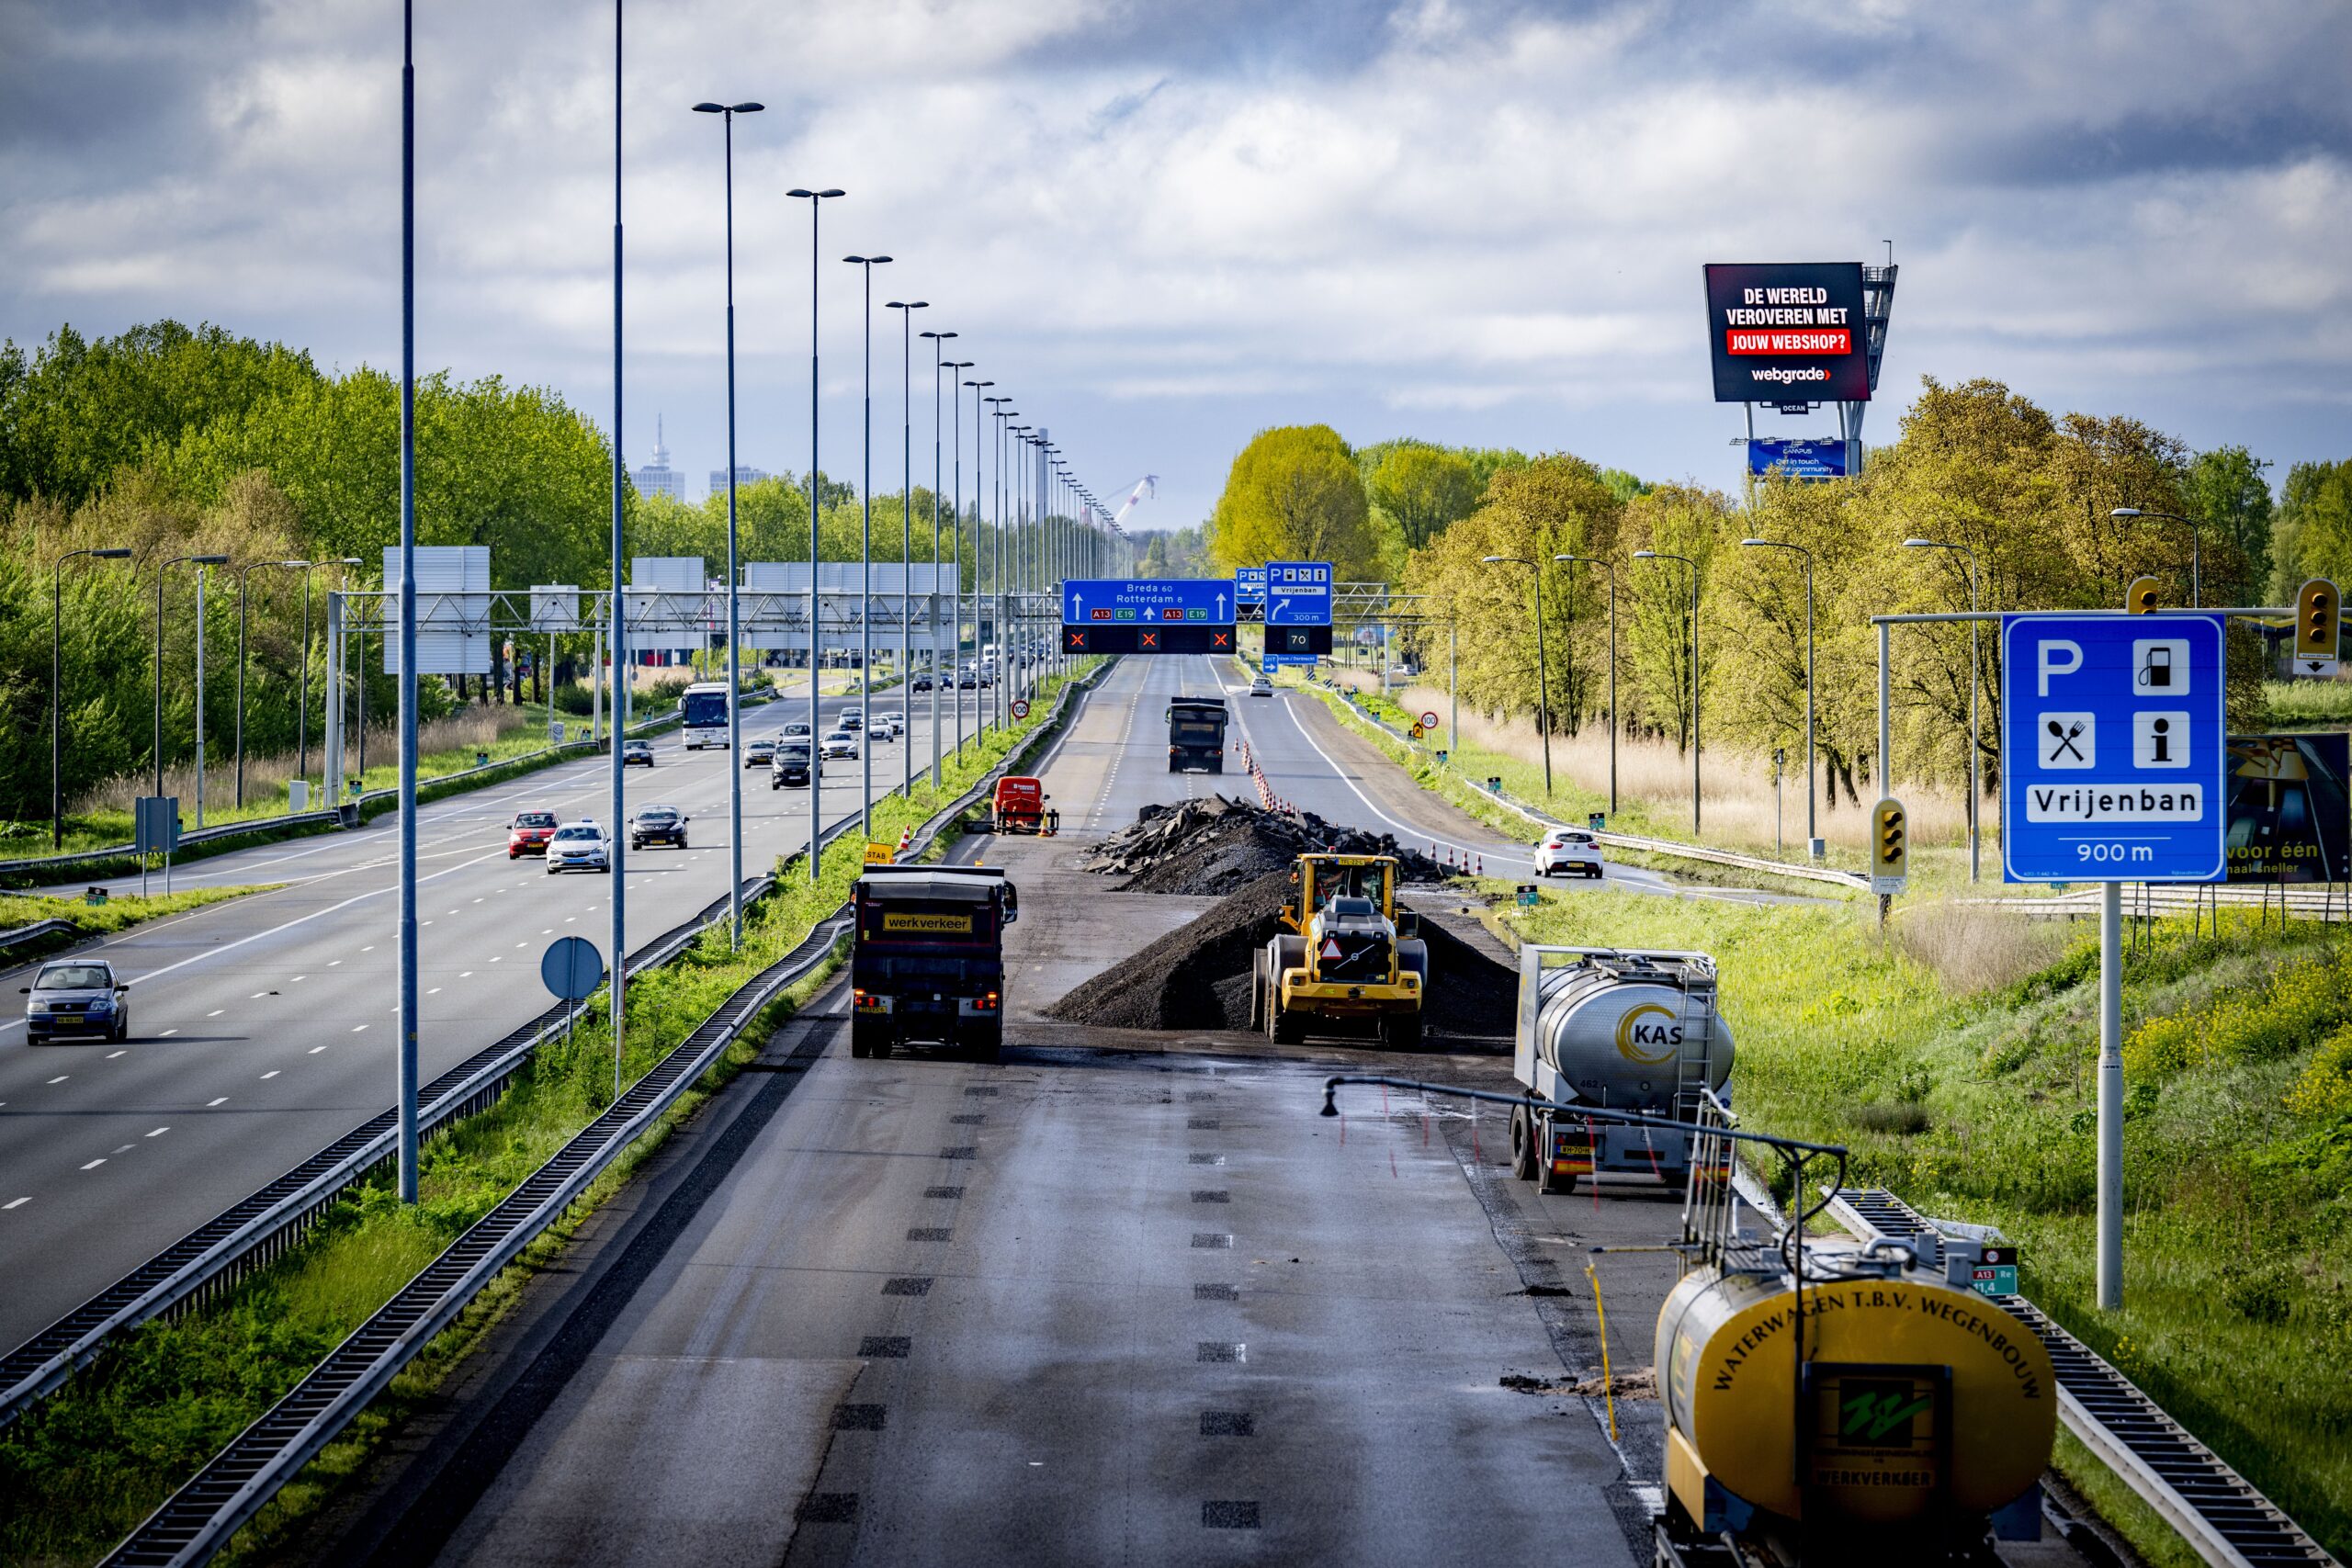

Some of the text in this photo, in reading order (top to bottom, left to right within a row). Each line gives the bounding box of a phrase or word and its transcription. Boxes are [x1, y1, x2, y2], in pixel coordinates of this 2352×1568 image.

[1744, 288, 1827, 304] DE WERELD
[1725, 308, 1848, 325] VEROVEREN MET
[1732, 334, 1846, 350] JOUW WEBSHOP?
[1751, 367, 1826, 384] webgrade
[1126, 584, 1159, 592] Breda
[1116, 594, 1174, 604] Rotterdam
[1092, 610, 1134, 618] A13 E19
[1164, 610, 1205, 618] A13 E19
[1291, 635, 1306, 645] 70
[1015, 705, 1027, 714] 100
[1424, 716, 1436, 725] 100
[2034, 789, 2197, 819] Vrijenban
[2076, 844, 2154, 862] 900 m
[2226, 840, 2318, 860] voor één
[2256, 863, 2299, 874] sneller
[888, 917, 967, 930] werkverkeer
[1634, 1024, 1683, 1045] KAS
[1580, 1079, 1599, 1089] 462
[1976, 1270, 1993, 1279] A13
[1713, 1291, 2041, 1400] WATERWAGEN T.B.V. WEGENBOUW
